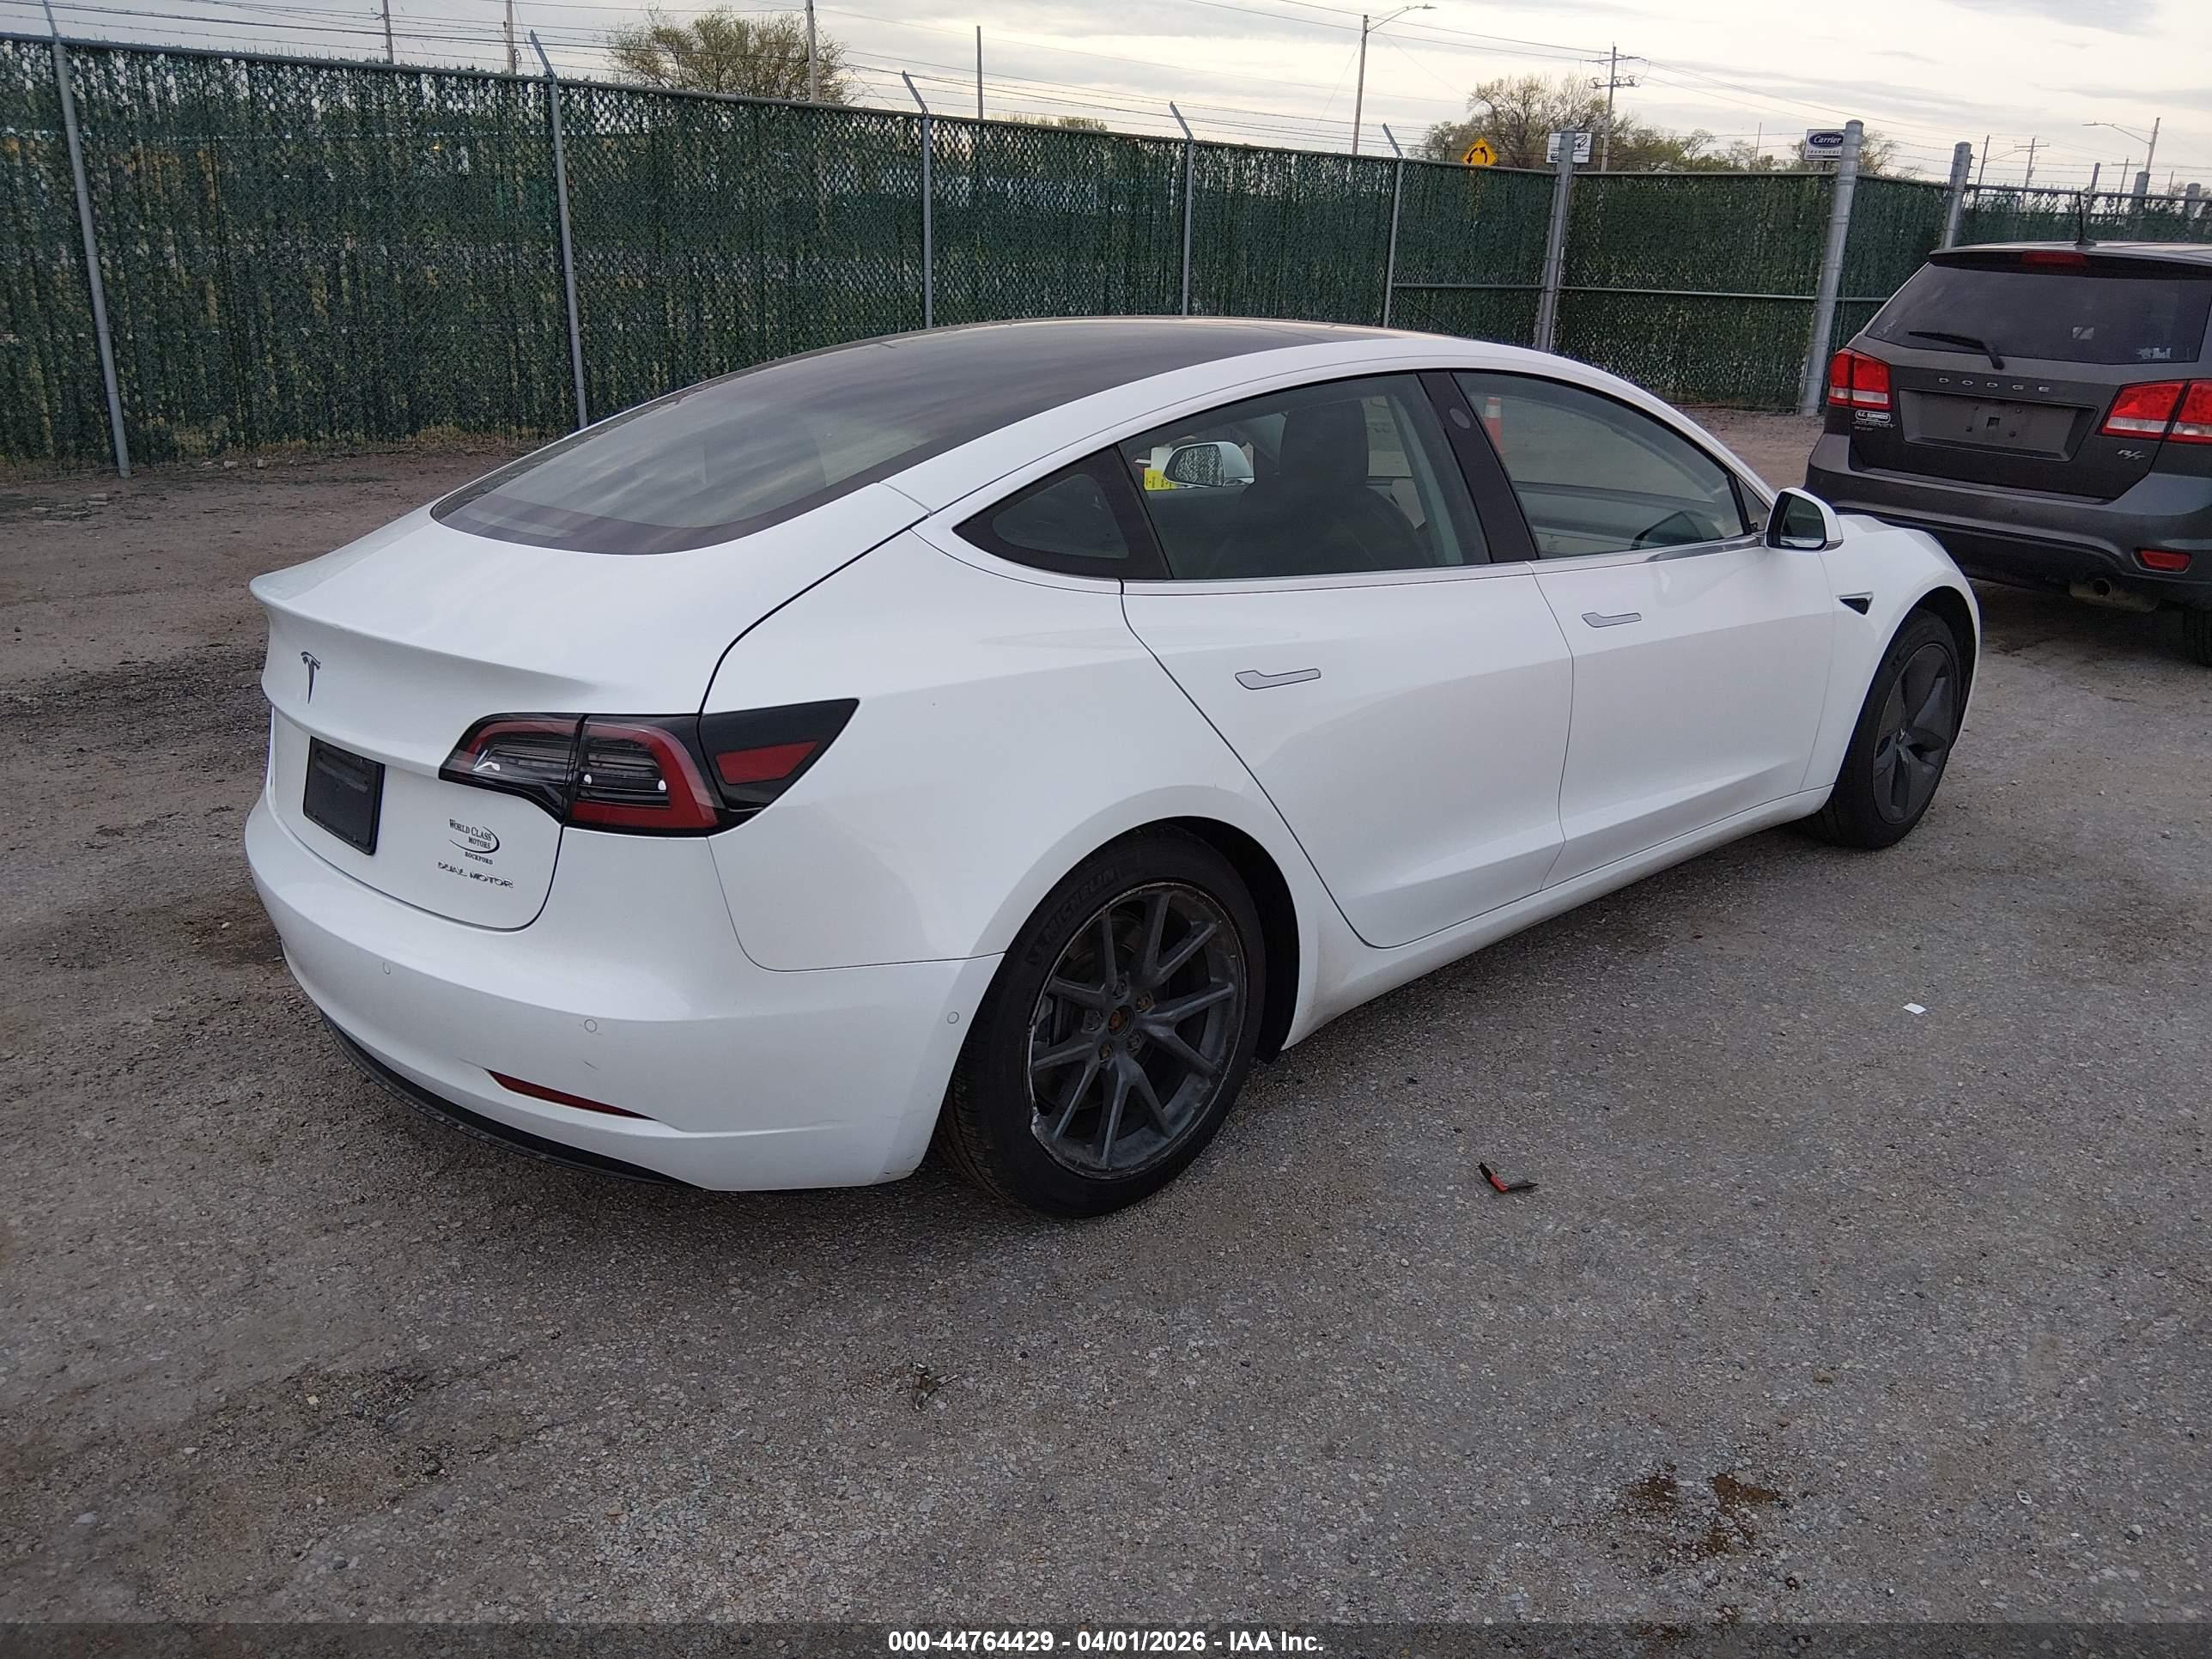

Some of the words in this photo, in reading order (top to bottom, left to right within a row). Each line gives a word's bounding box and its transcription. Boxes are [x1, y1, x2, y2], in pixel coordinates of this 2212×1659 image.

[1938, 377, 2050, 392] DODGE
[449, 818, 470, 834] WORLD
[468, 836, 491, 849] MOTORS
[465, 852, 493, 865] ROCKFORD
[438, 861, 467, 877] DUAL
[470, 872, 514, 888] MOTOR
